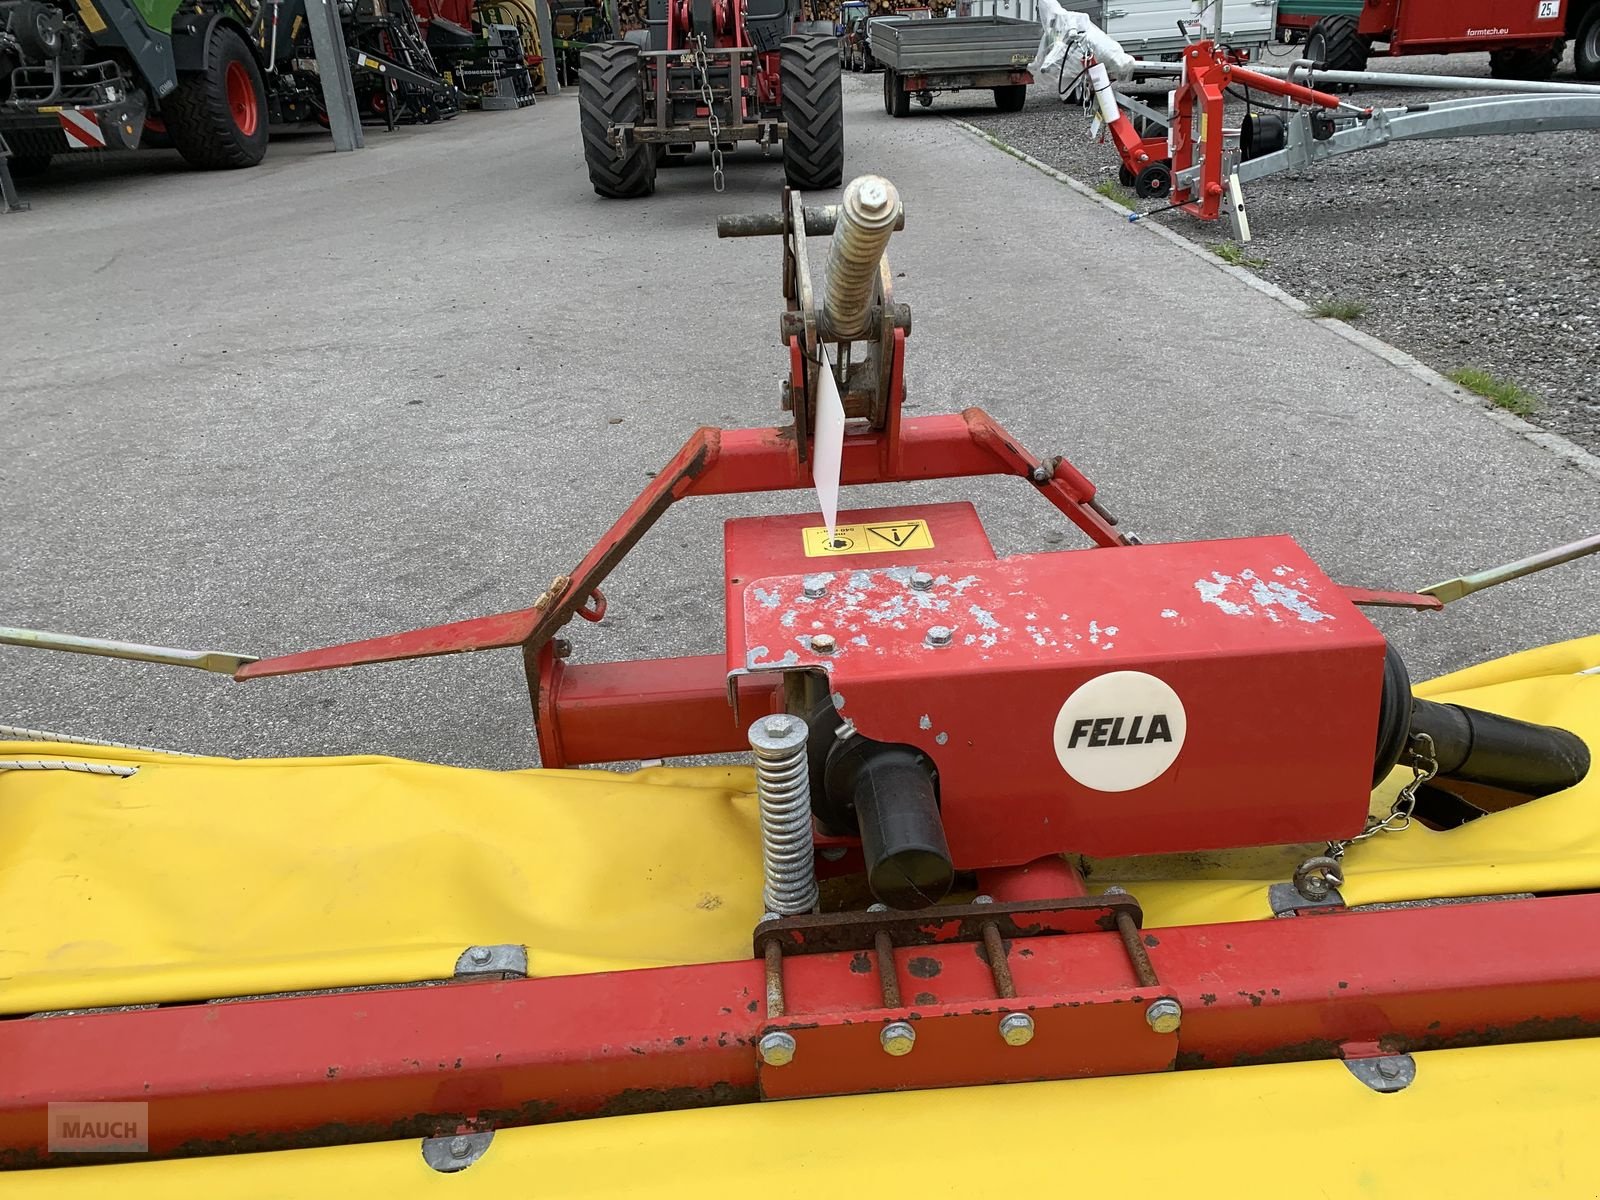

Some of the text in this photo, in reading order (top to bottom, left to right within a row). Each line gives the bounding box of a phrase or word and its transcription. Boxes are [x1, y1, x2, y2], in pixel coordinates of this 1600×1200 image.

[1541, 3, 1552, 16] 25
[1467, 27, 1509, 36] farmtech.eu
[1067, 714, 1173, 749] FELLA
